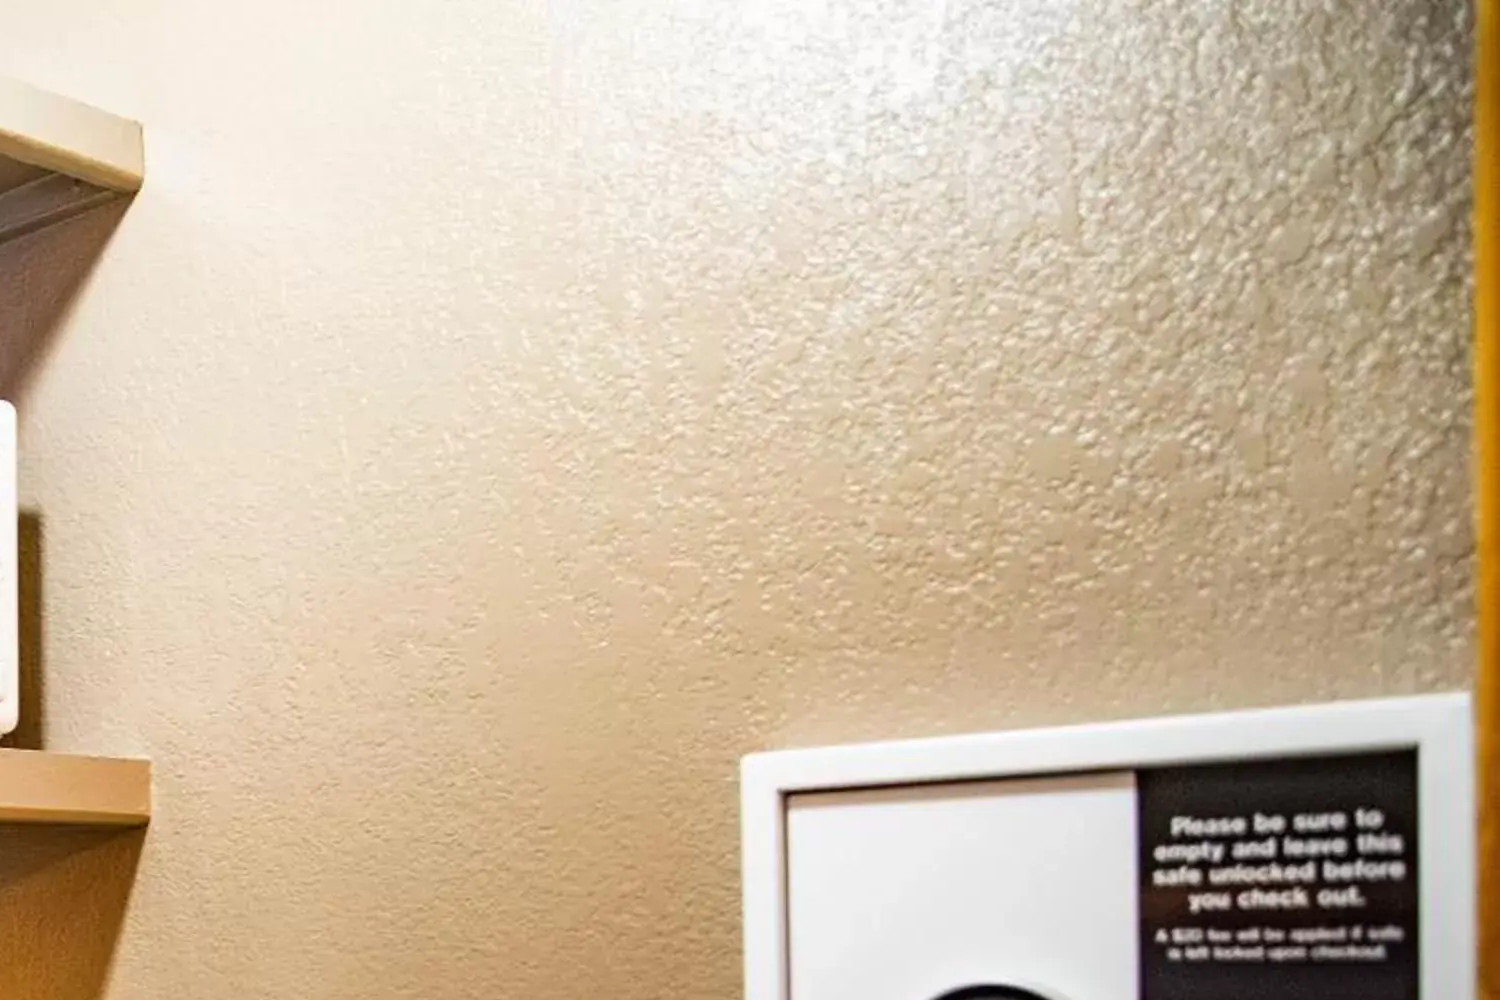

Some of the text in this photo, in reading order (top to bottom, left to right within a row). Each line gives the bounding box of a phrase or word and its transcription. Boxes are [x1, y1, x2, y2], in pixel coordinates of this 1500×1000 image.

[1170, 808, 1384, 836] Please be sure to
[1153, 833, 1403, 863] empty and leave this
[1152, 859, 1406, 885] safe unlocked before
[1188, 886, 1365, 914] you check out.
